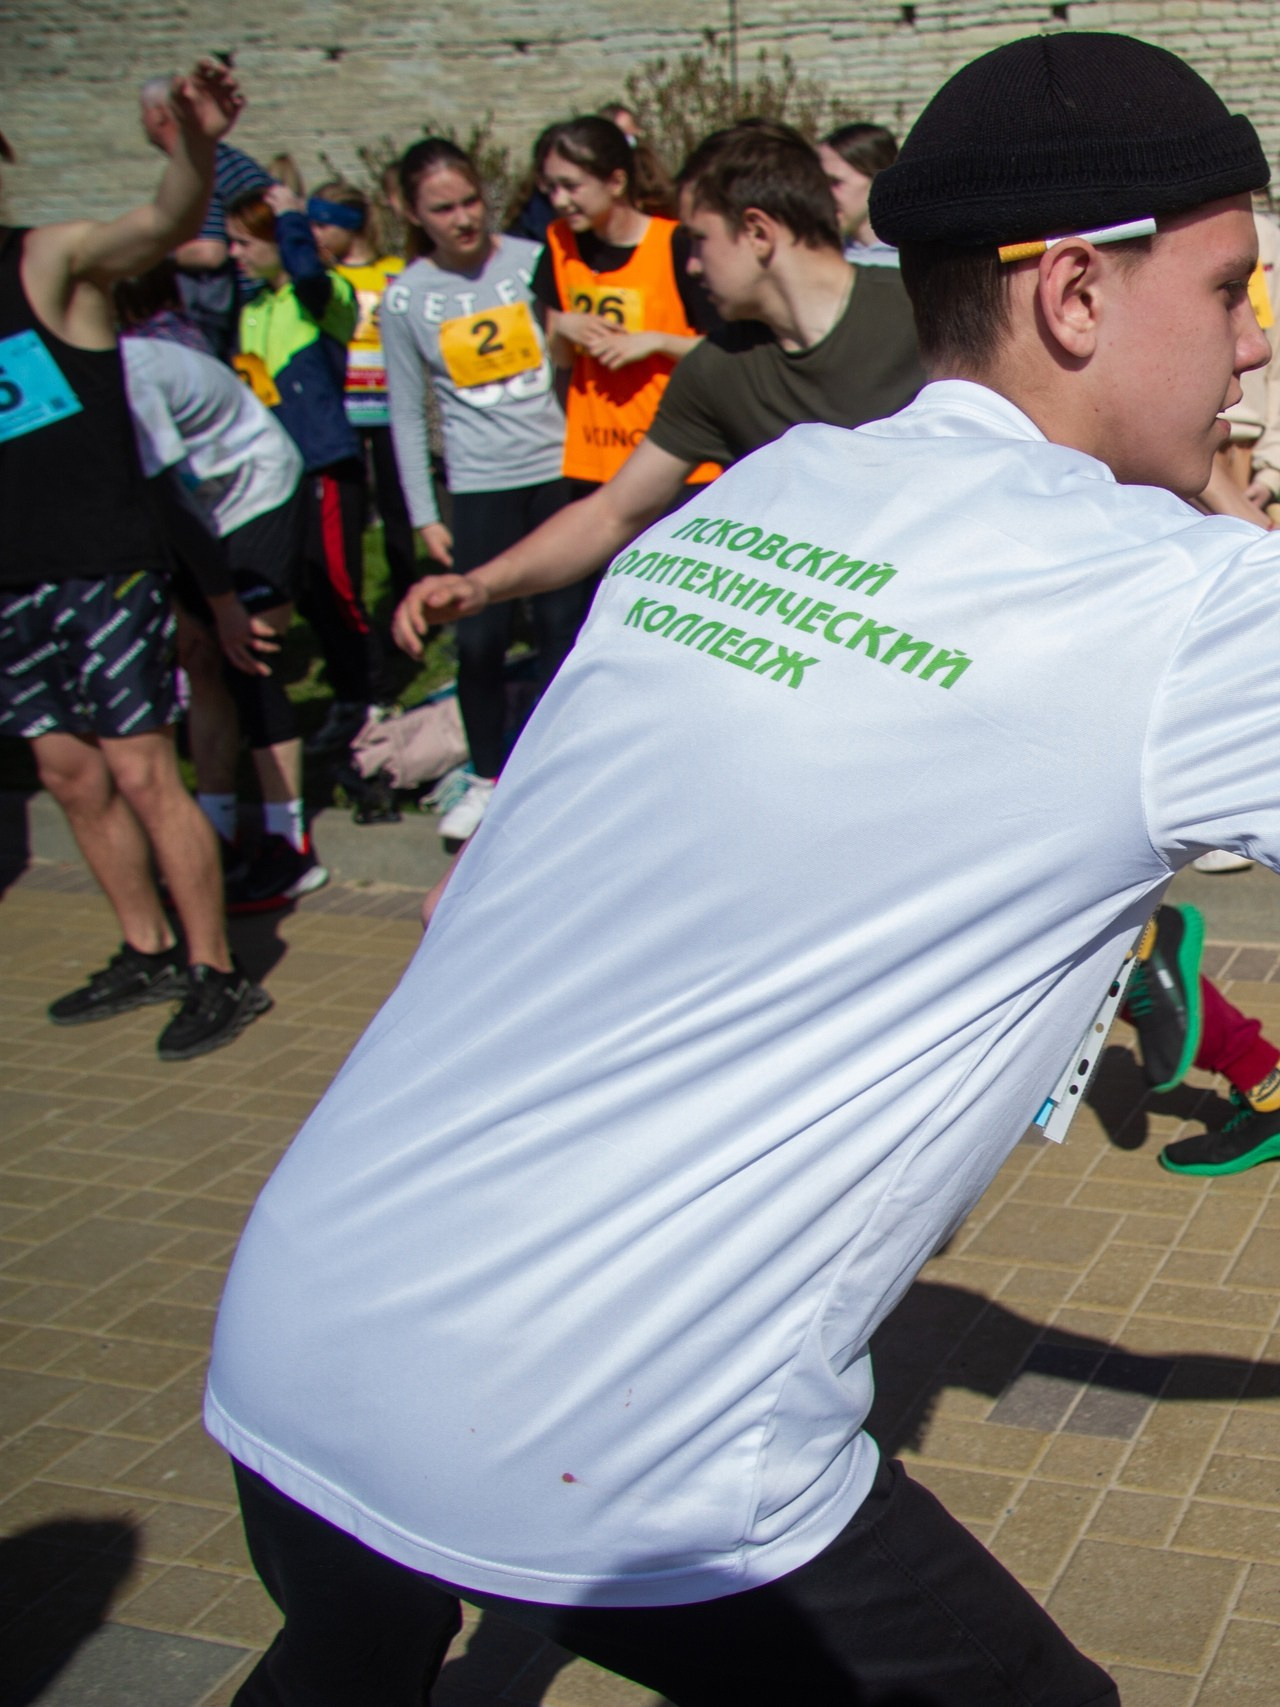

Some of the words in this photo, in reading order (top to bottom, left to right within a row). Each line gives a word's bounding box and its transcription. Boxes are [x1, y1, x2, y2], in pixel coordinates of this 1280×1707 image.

[471, 319, 504, 356] 2
[669, 517, 899, 597] ПСКОВСКИЙ
[604, 549, 974, 690] ОЛИТЕХНИЧЕСКИЙ
[623, 596, 822, 690] КОЛЛЕДЖ
